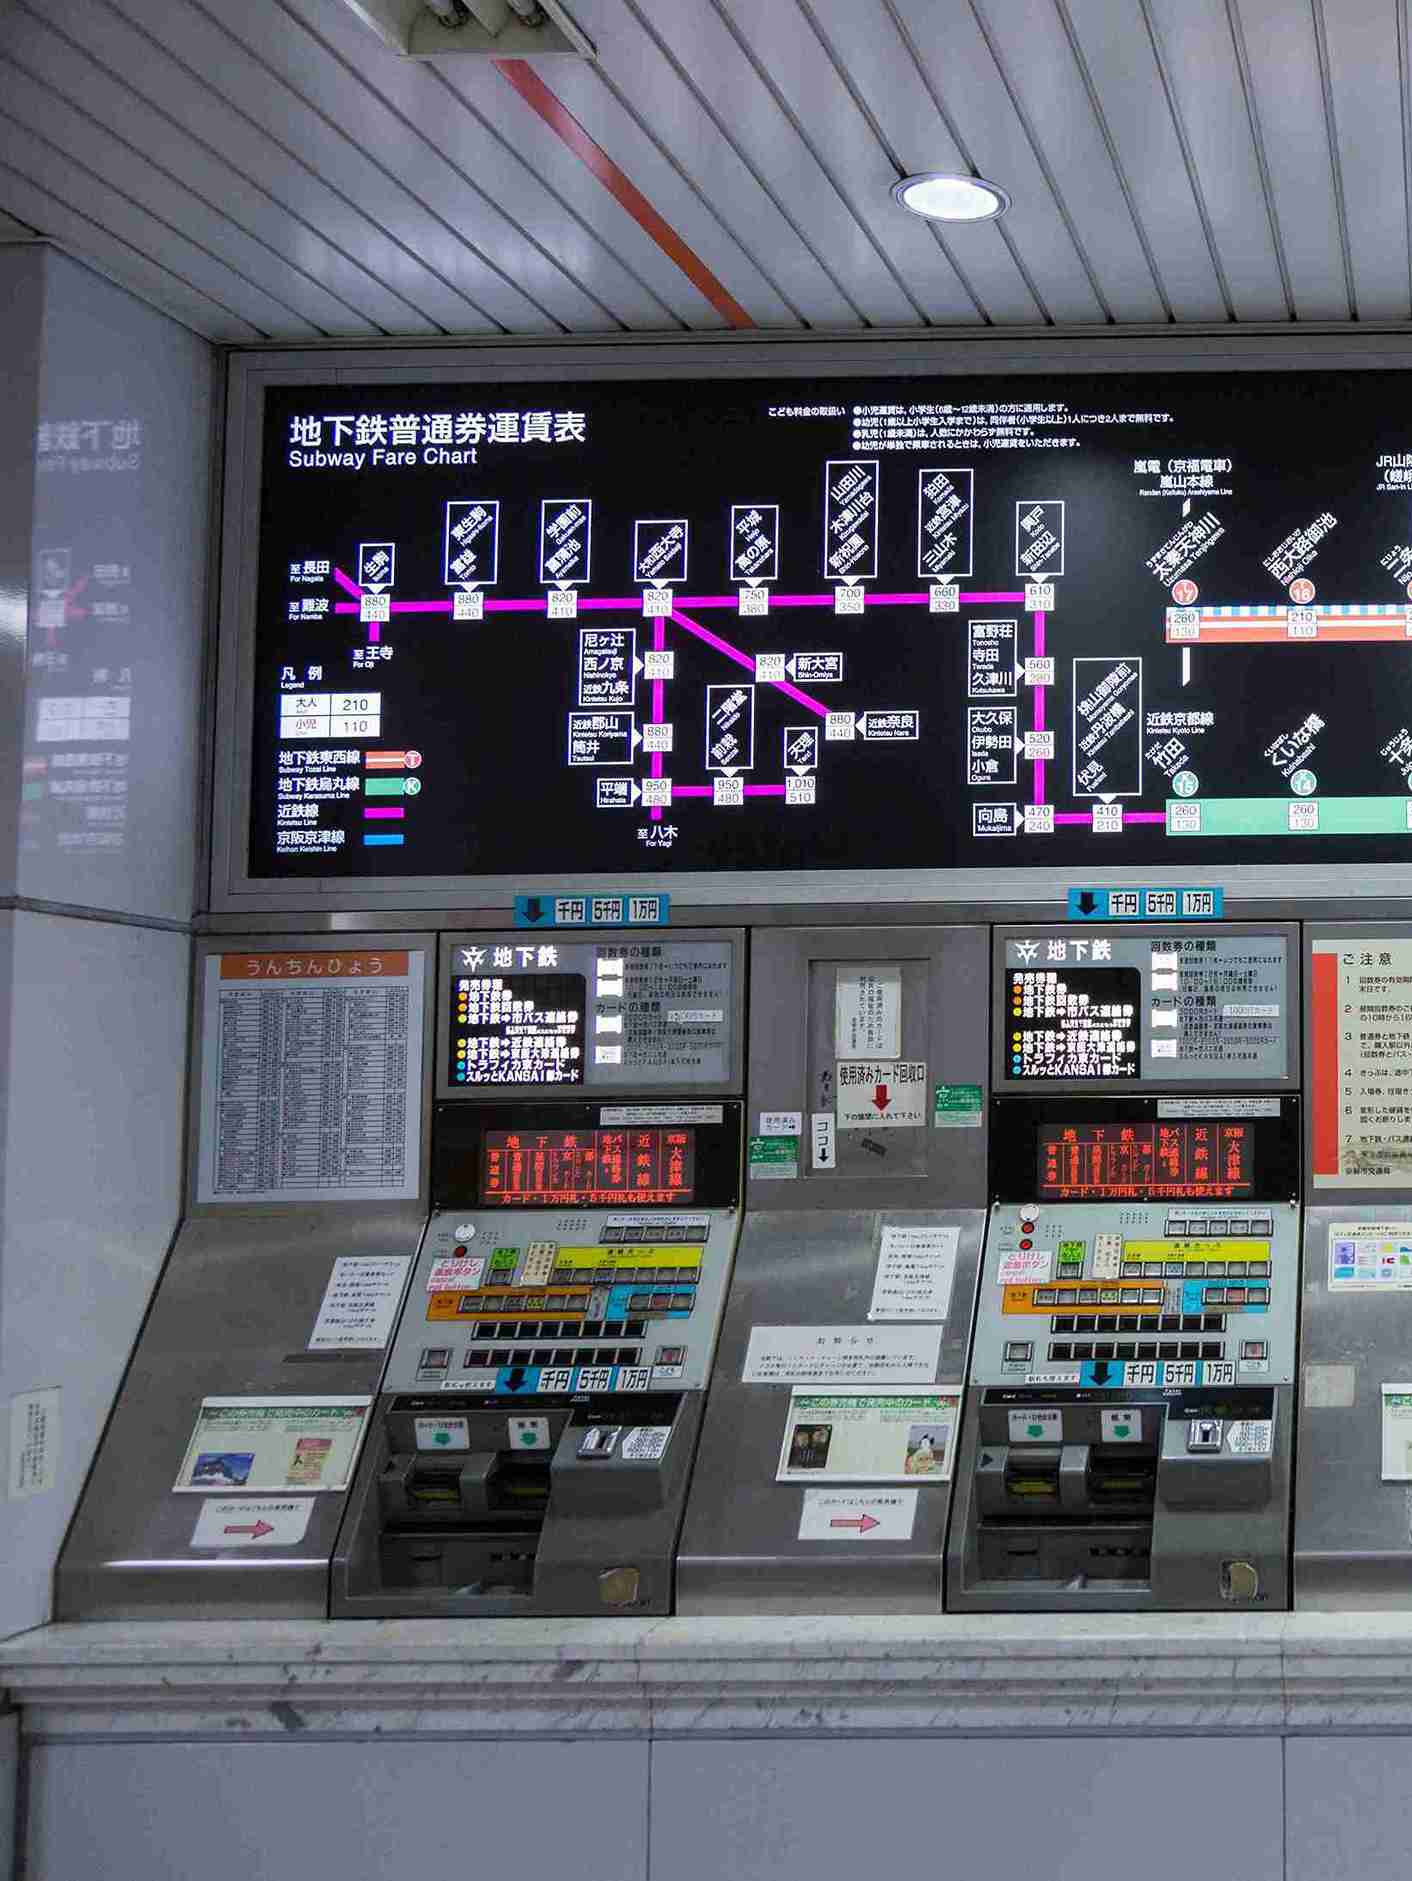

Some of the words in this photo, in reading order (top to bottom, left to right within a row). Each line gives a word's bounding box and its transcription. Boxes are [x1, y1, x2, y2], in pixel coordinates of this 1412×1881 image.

[290, 411, 586, 447] 地下鉄普通券運賃表
[289, 449, 366, 470] Subway
[372, 449, 417, 466] Fare
[423, 447, 478, 465] Chart
[798, 656, 838, 671] 新大宮
[972, 648, 999, 662] 寺田
[584, 657, 624, 672] 西ノ京
[343, 699, 369, 711] 210
[343, 720, 368, 732] 110
[971, 711, 1013, 726] 大久保
[1146, 711, 1215, 727] 近鉄京都線
[278, 750, 361, 766] 地下鉄東西線
[1293, 804, 1315, 815] 260
[557, 900, 584, 921] 千円
[592, 899, 622, 921] 5千円
[631, 898, 657, 920] 1万円
[1111, 894, 1138, 914] 千円
[1148, 893, 1175, 913] 5千円
[1186, 893, 1212, 913] 1万円
[493, 946, 559, 967] 地下鉄
[1047, 939, 1112, 961] 地下鉄
[247, 956, 385, 976] うんちんひょう
[1343, 952, 1393, 967] ご注意
[840, 1065, 925, 1086] 使用済みカード回収口
[540, 1369, 570, 1389] 千円
[579, 1369, 610, 1389] 5千円
[620, 1368, 648, 1389] 1万円
[1126, 1364, 1154, 1384] 千円
[1165, 1364, 1194, 1384] 5千円
[1207, 1364, 1233, 1383] 1万円
